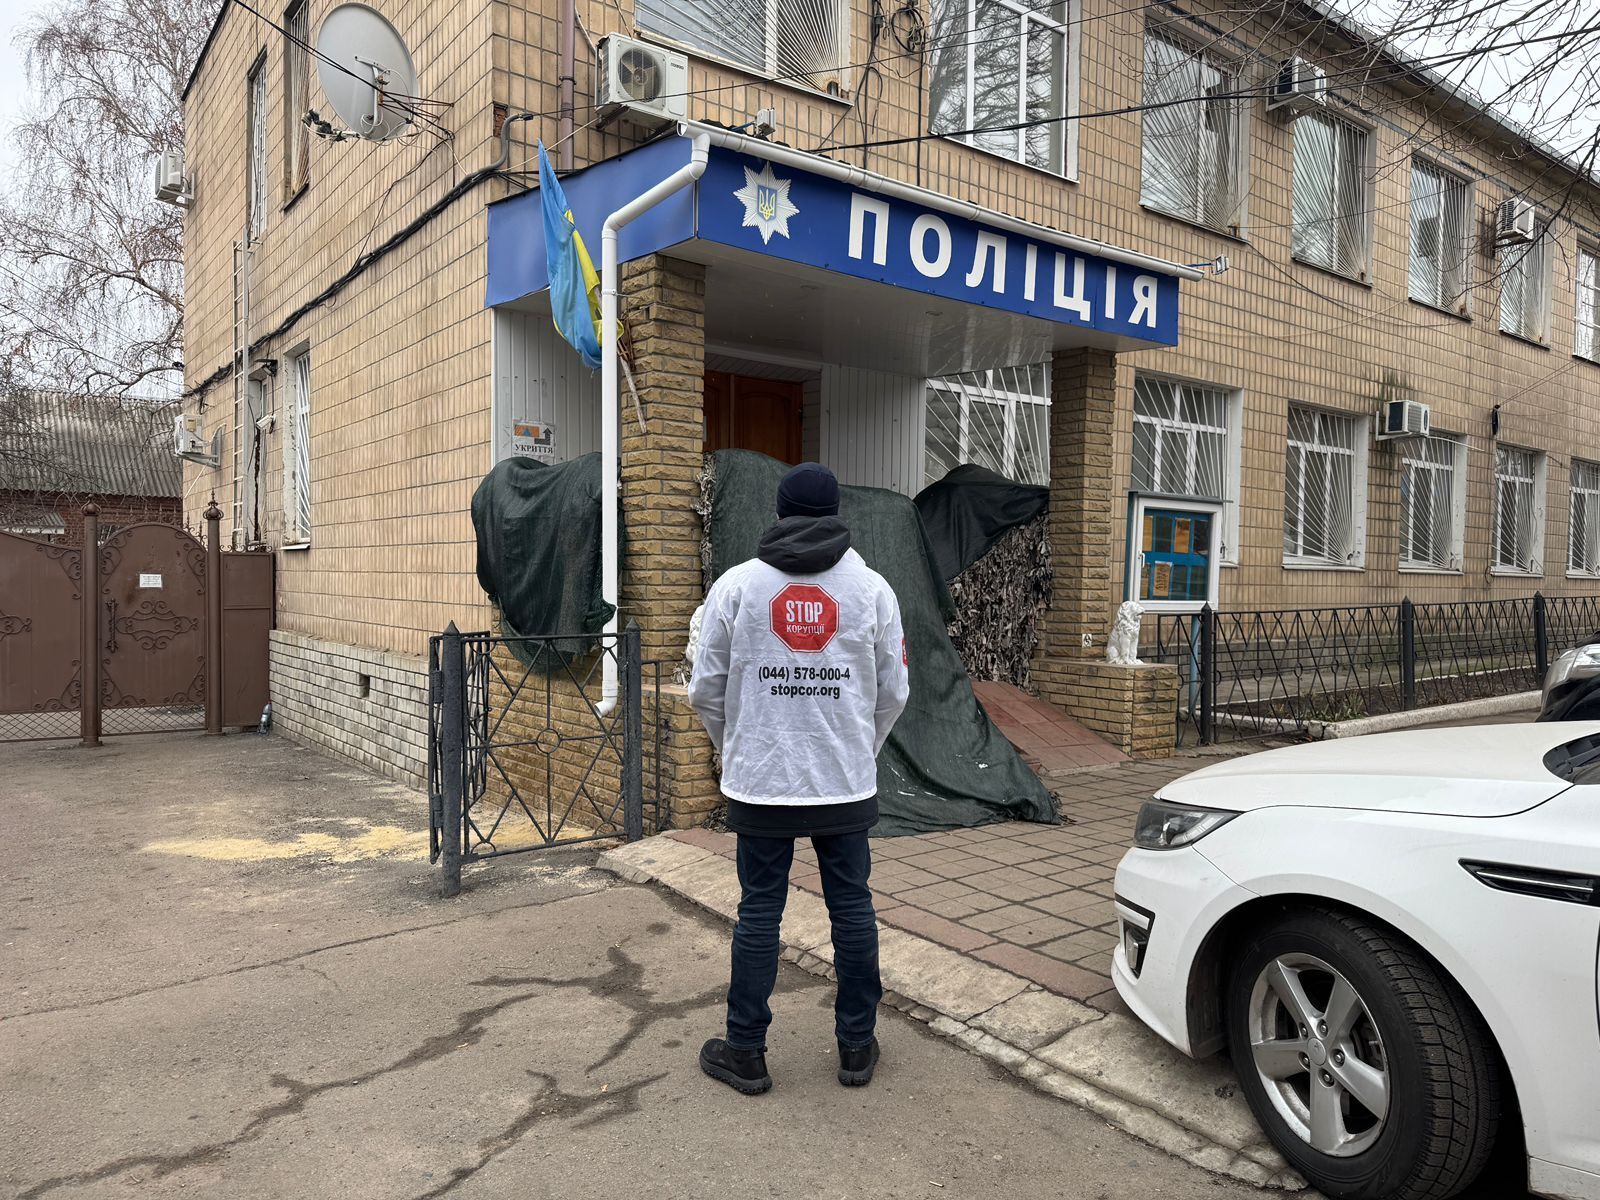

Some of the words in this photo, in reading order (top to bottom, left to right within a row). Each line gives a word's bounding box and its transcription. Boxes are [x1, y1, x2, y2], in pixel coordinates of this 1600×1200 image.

[847, 192, 1158, 329] ПОЛІЦІЯ
[515, 444, 553, 454] УКРИТТЯ
[785, 600, 823, 623] STOP
[786, 623, 825, 635] КОРУПЦІЇ
[758, 666, 789, 682] (044)
[793, 667, 850, 681] 578-000-4
[770, 684, 840, 699] stopcor.org
